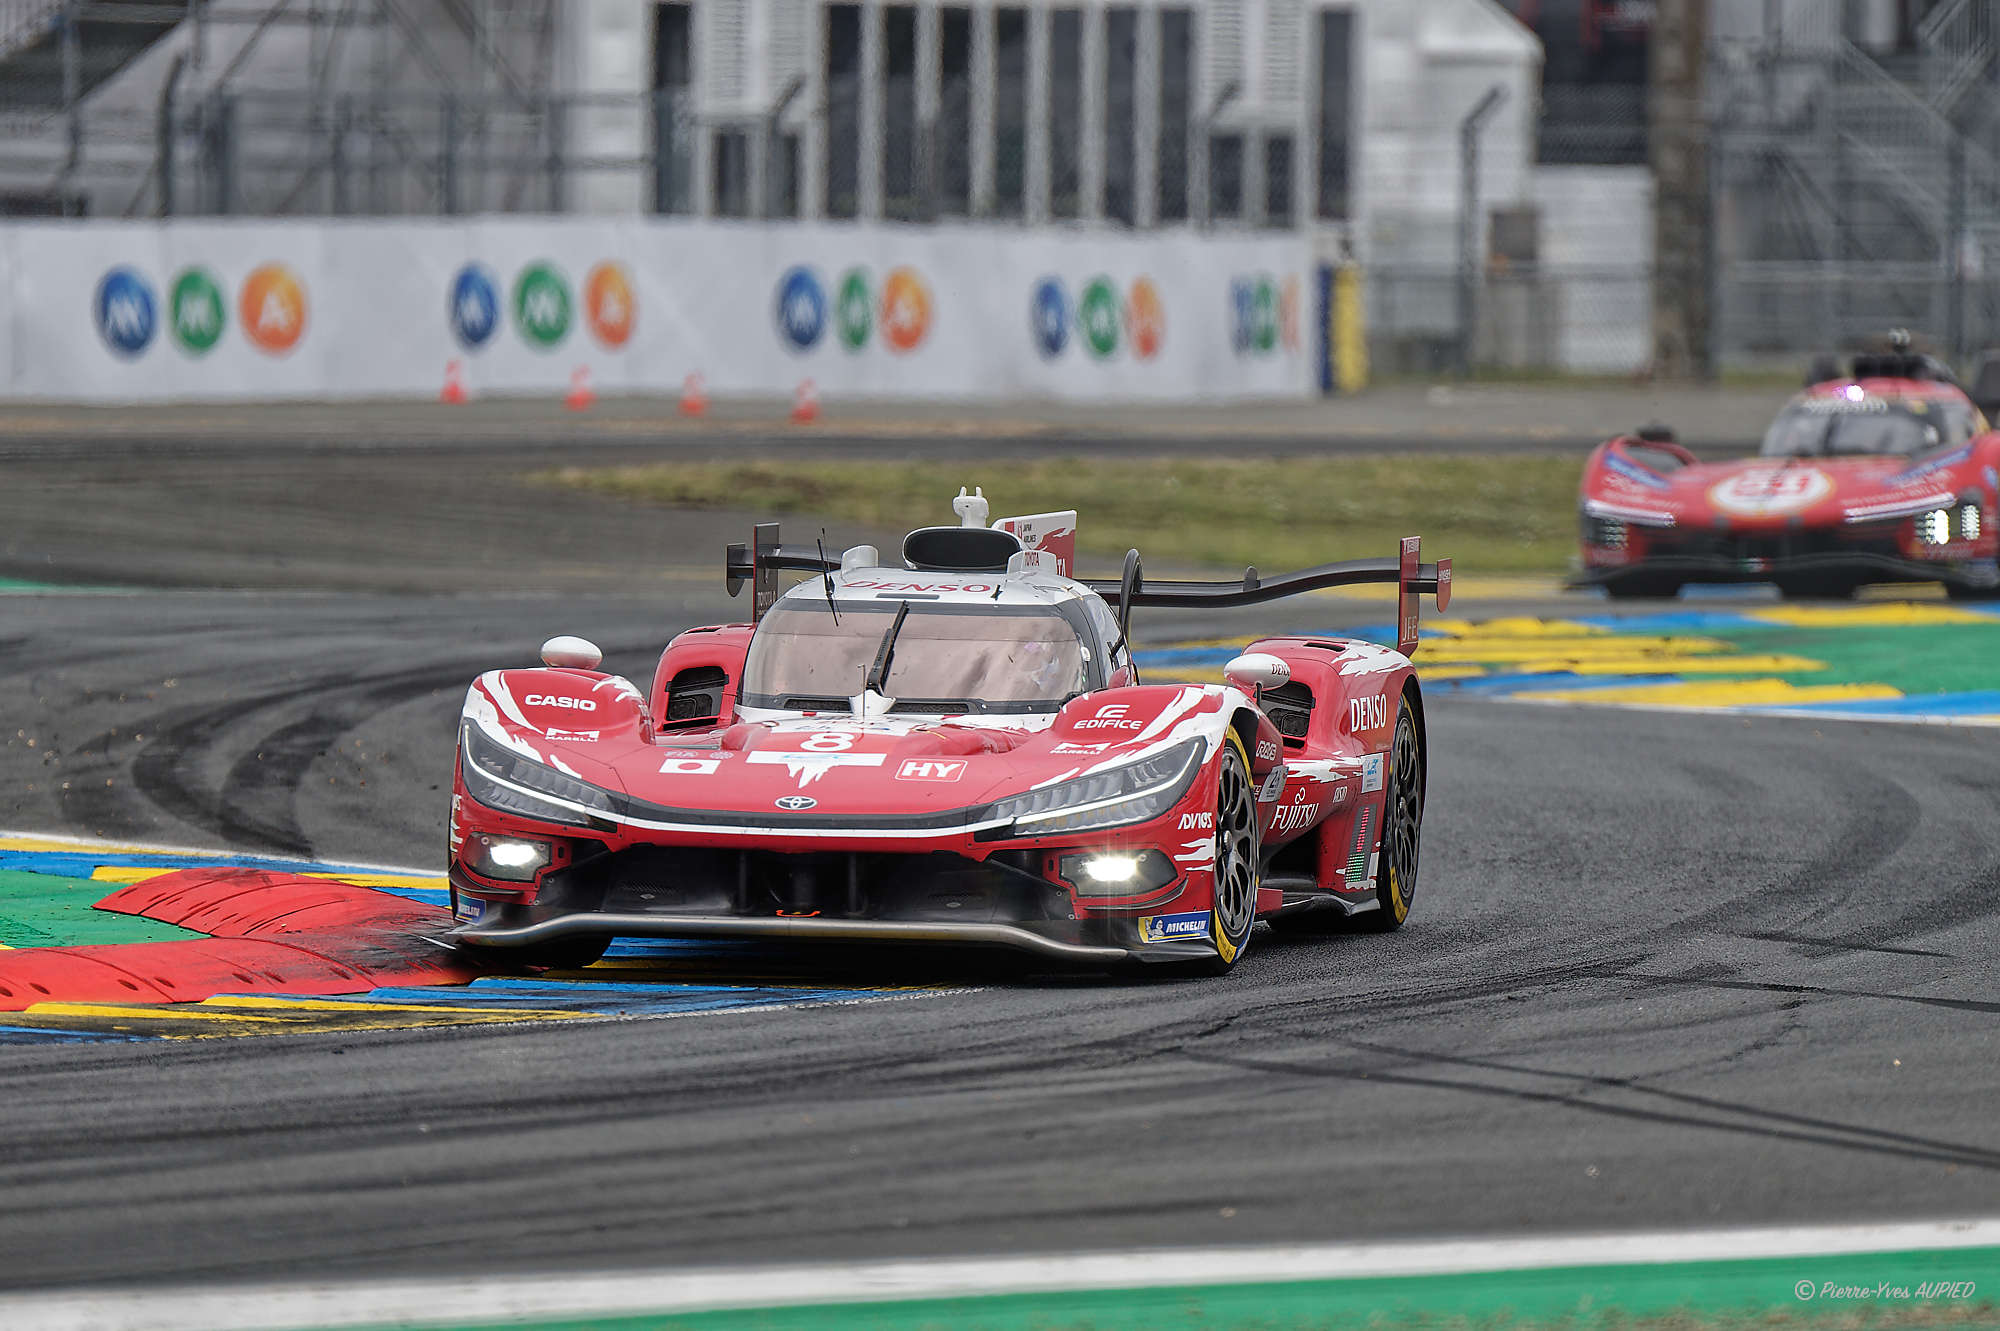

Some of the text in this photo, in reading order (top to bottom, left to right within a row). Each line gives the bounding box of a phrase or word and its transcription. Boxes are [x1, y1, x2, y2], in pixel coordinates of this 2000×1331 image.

[842, 581, 991, 592] DENSO
[1402, 616, 1417, 641] JFE
[525, 694, 597, 712] CASIO
[1350, 693, 1387, 733] DENSO
[1072, 719, 1143, 730] EDIFICE
[800, 732, 855, 752] 8
[901, 761, 962, 778] HY
[1269, 803, 1320, 837] FUJITSU
[1165, 920, 1207, 934] MICHELIN
